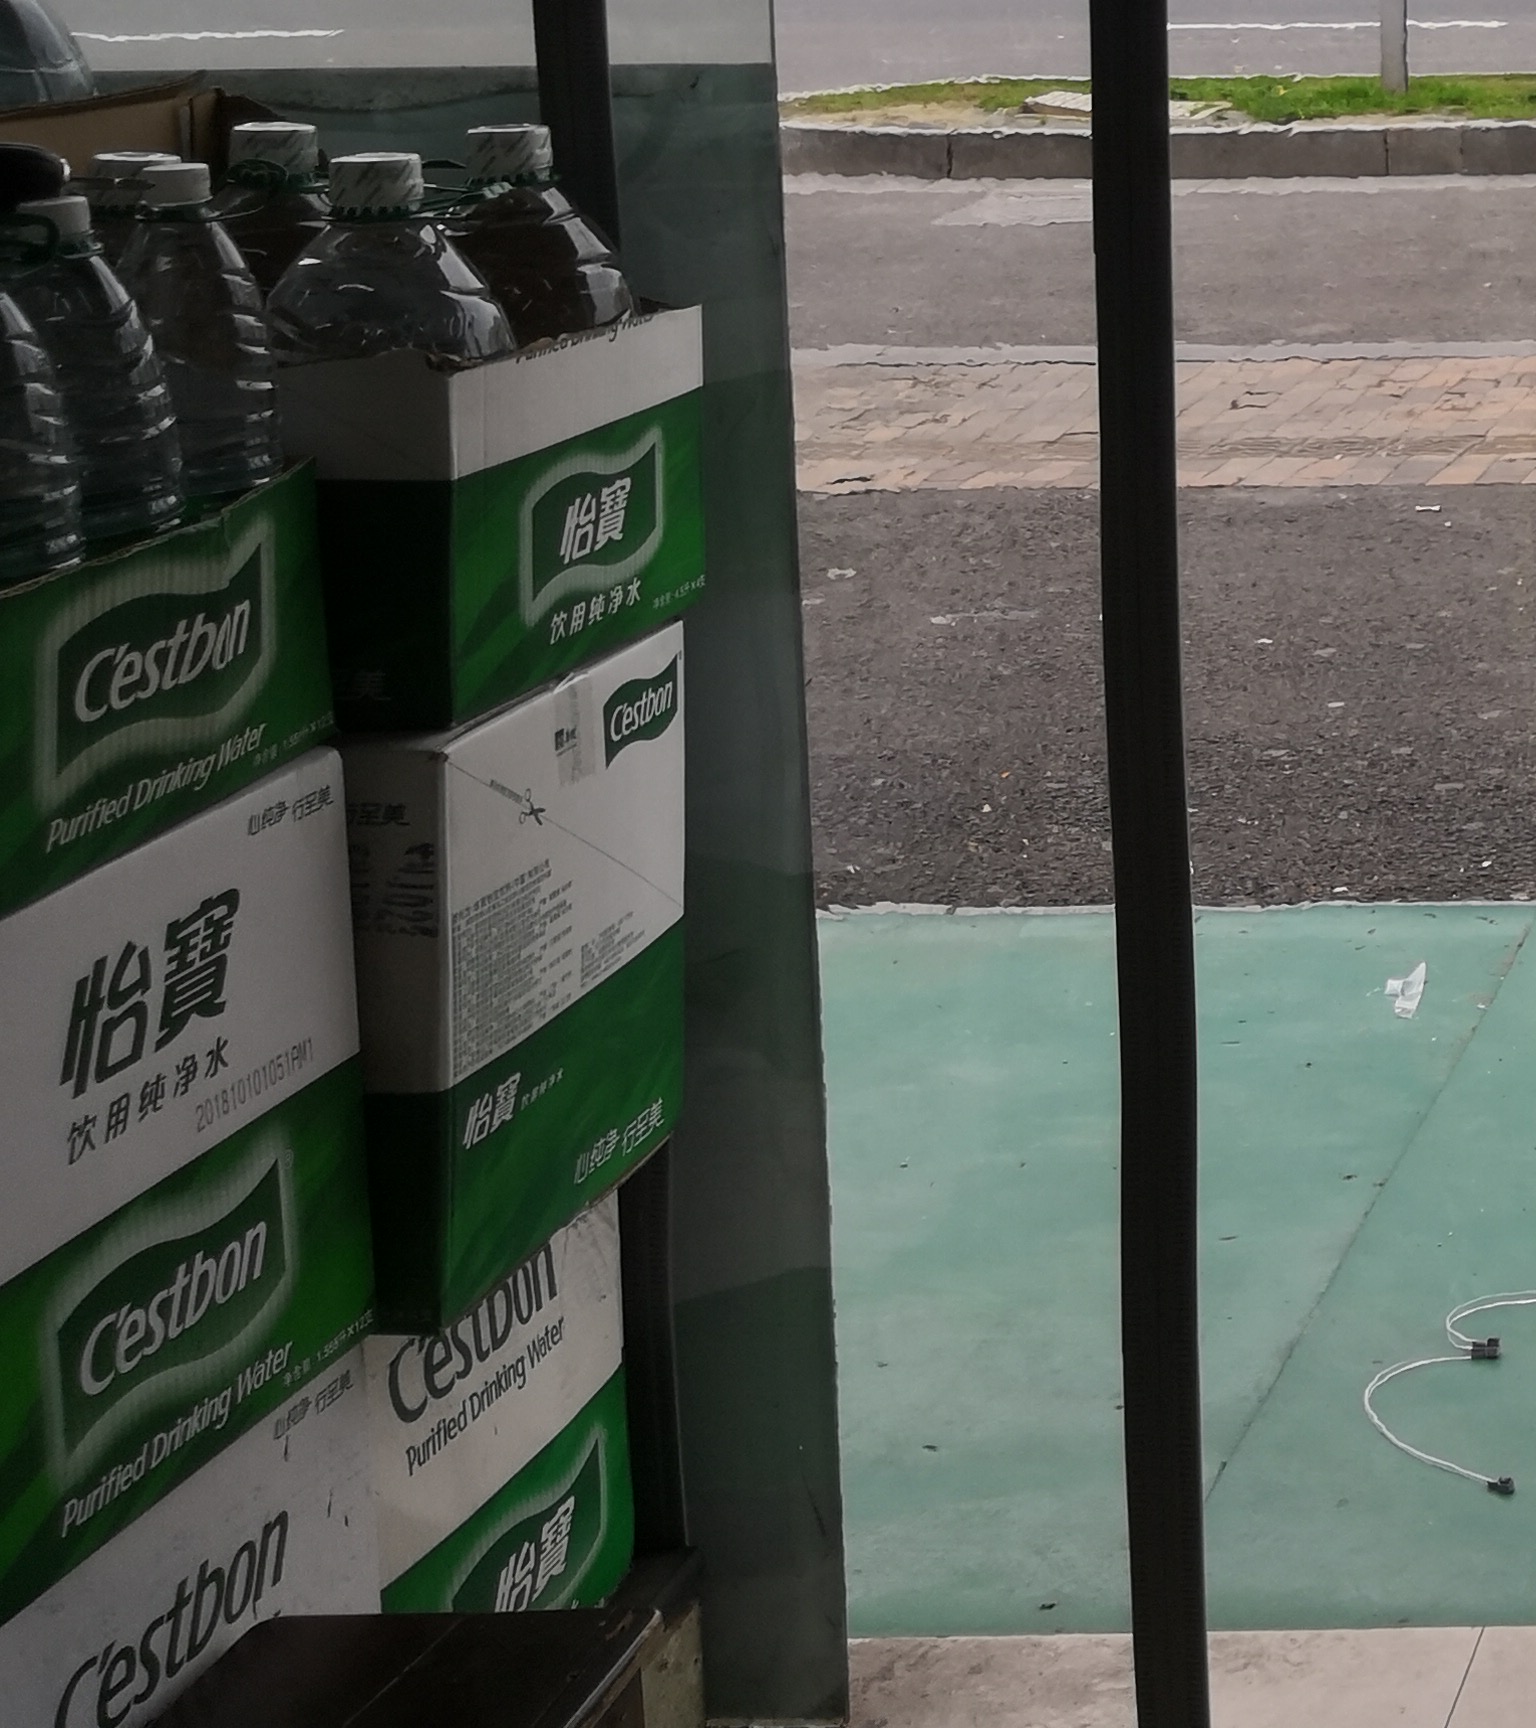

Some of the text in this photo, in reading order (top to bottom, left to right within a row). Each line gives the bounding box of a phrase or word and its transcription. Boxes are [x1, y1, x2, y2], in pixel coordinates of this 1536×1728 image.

[560, 477, 632, 565] 怡寶
[74, 599, 251, 723] C'estbon
[550, 578, 642, 646] 饮用纯净水
[610, 680, 674, 742] C'estbon
[46, 723, 268, 853] Purified Drinking Water
[60, 888, 240, 1100] 怡寶
[67, 1036, 229, 1166] 饮用纯净水
[462, 1072, 522, 1151] 怡寶
[80, 1220, 268, 1396] C'estbon
[61, 1341, 294, 1538] Purified Drinking Water
[406, 1315, 566, 1478] Purified Drinking Water
[494, 1495, 575, 1613] 怡寶
